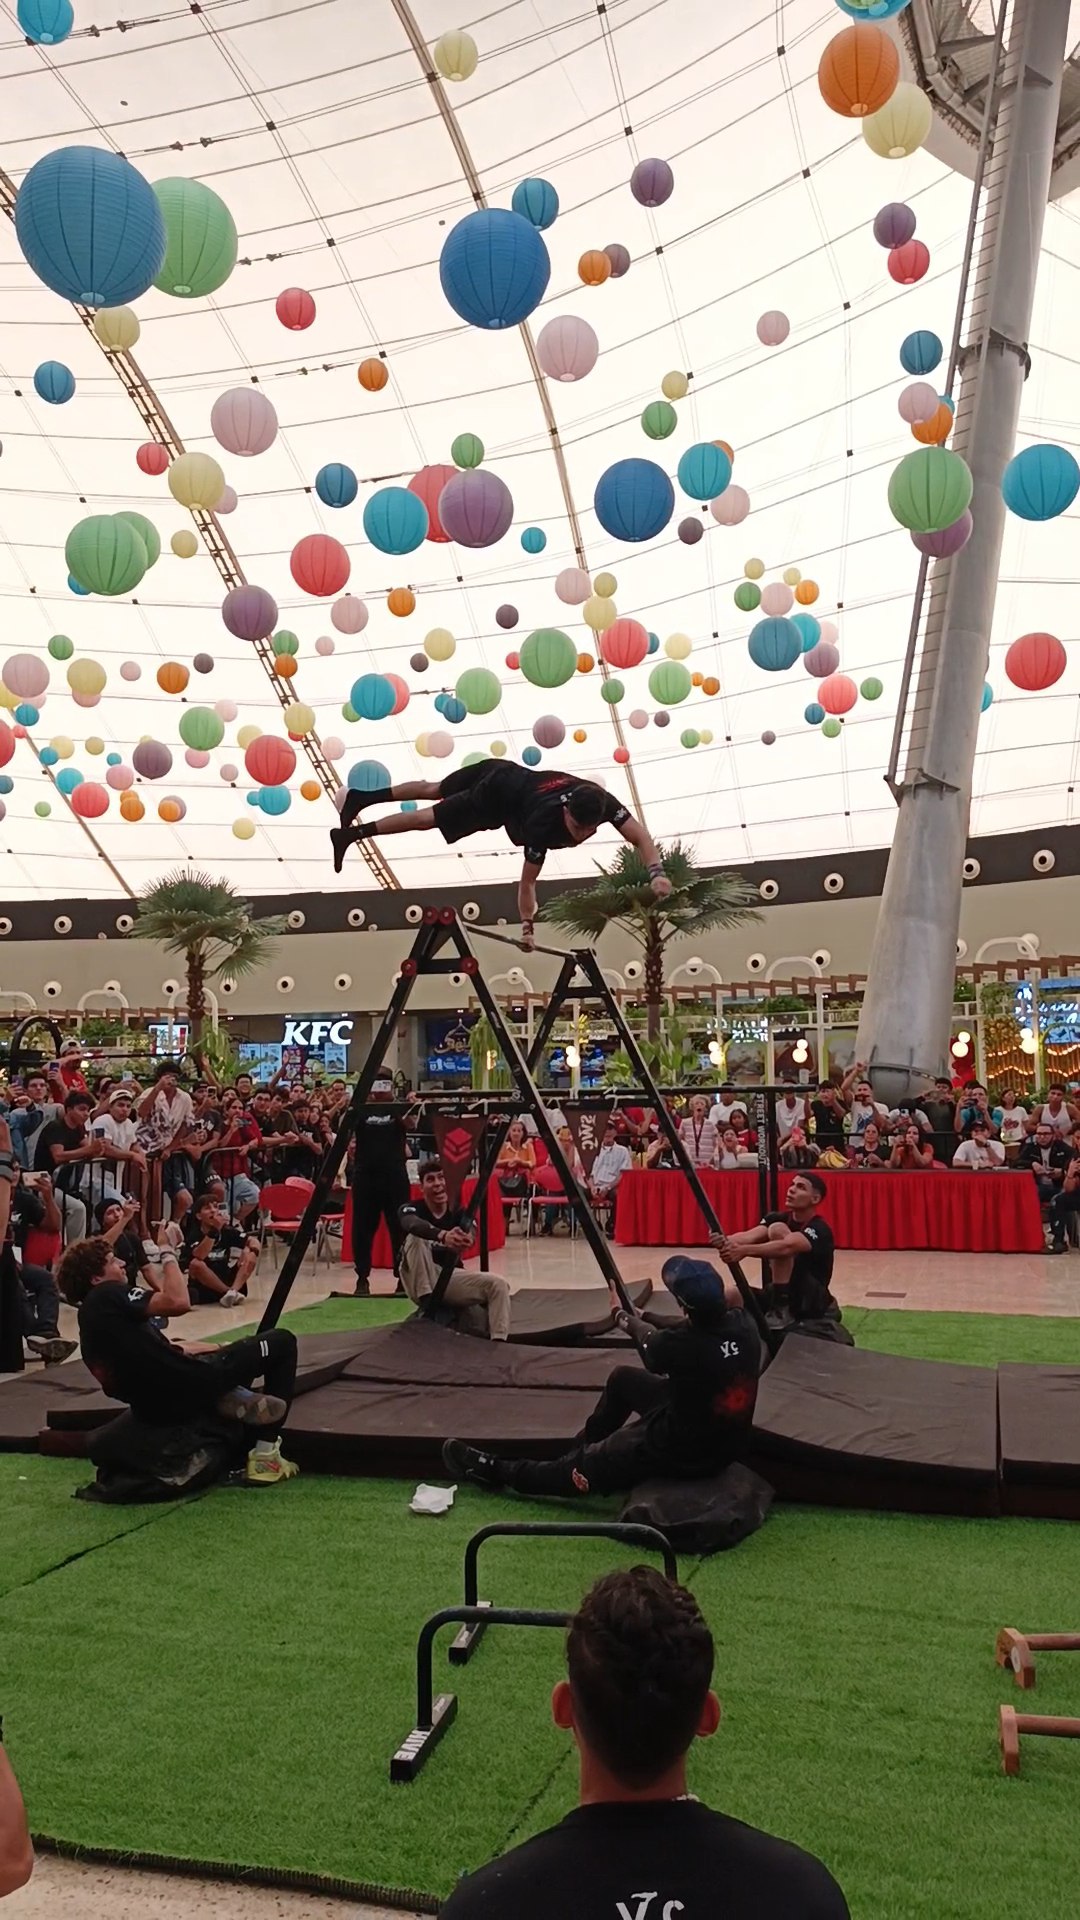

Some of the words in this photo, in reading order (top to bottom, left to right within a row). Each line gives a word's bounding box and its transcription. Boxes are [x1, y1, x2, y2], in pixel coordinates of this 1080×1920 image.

[281, 1020, 354, 1045] KFC
[756, 1093, 765, 1124] STREET
[757, 1125, 767, 1166] WORKOUT
